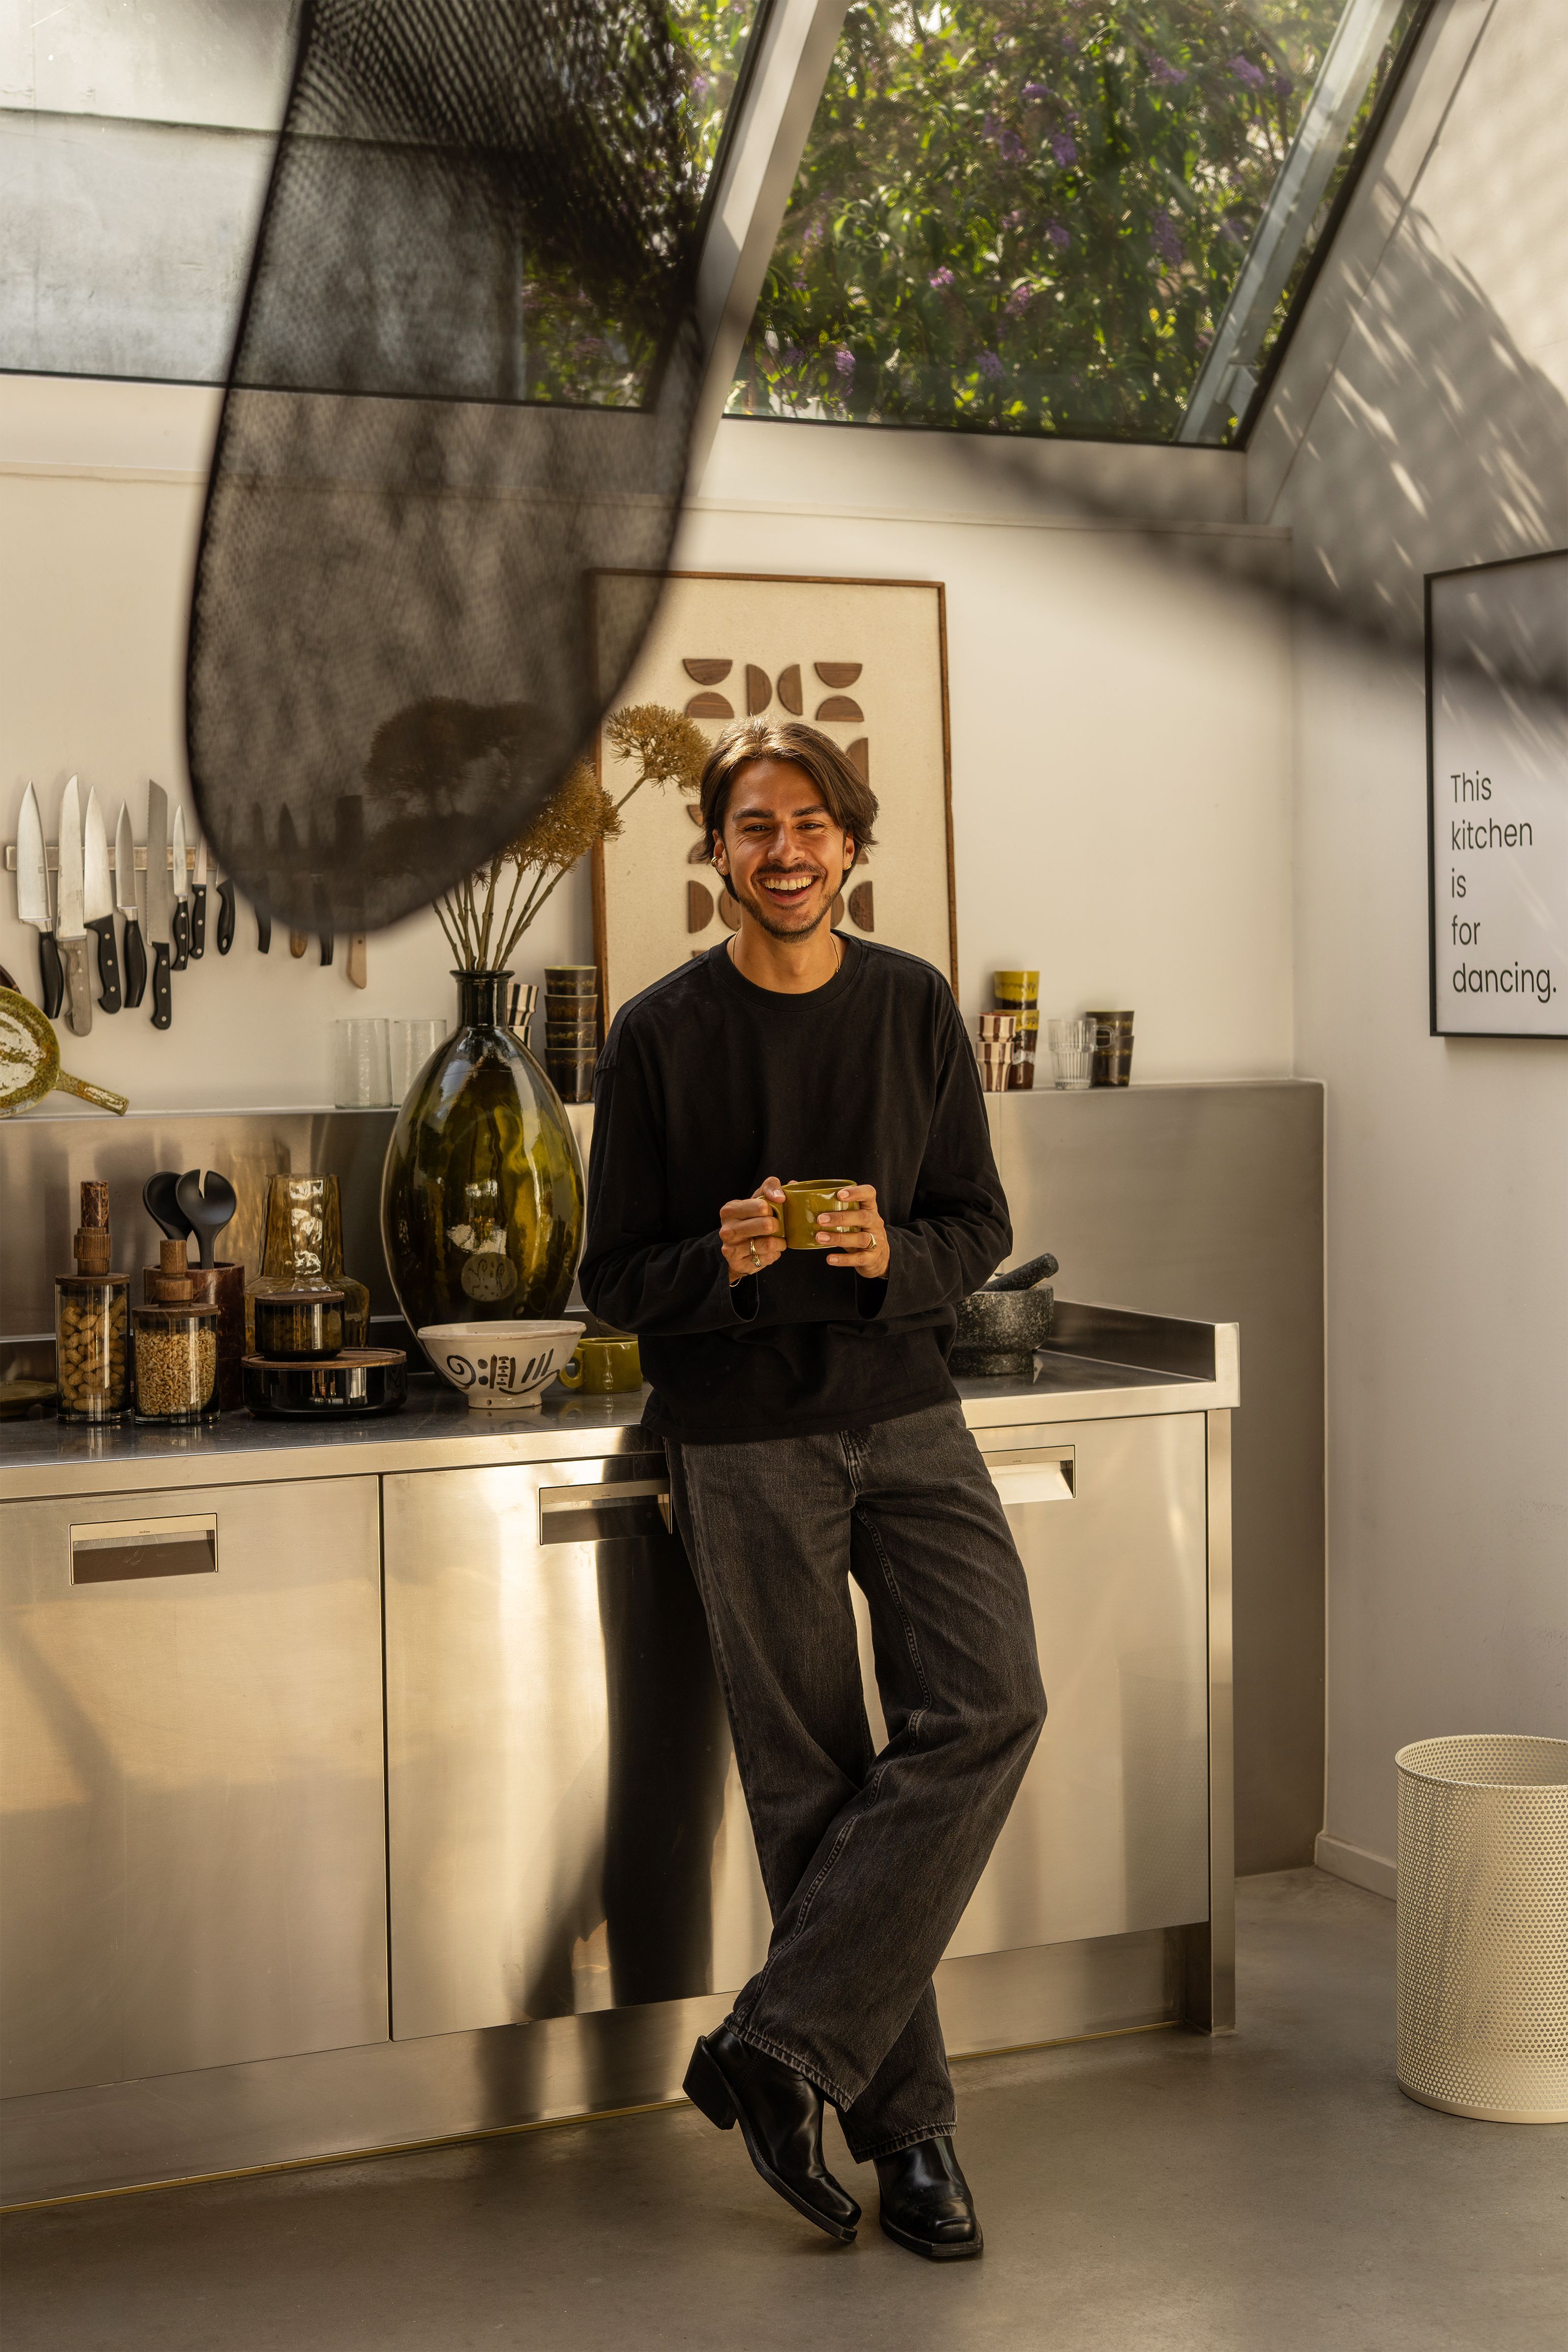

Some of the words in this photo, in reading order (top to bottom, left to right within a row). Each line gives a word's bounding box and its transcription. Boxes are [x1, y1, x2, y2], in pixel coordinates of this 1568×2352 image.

[1450, 770, 1492, 803] This
[1452, 818, 1532, 851] kitchen
[1452, 867, 1466, 898] is
[1452, 914, 1481, 946] for
[1453, 961, 1557, 1004] dancing.
